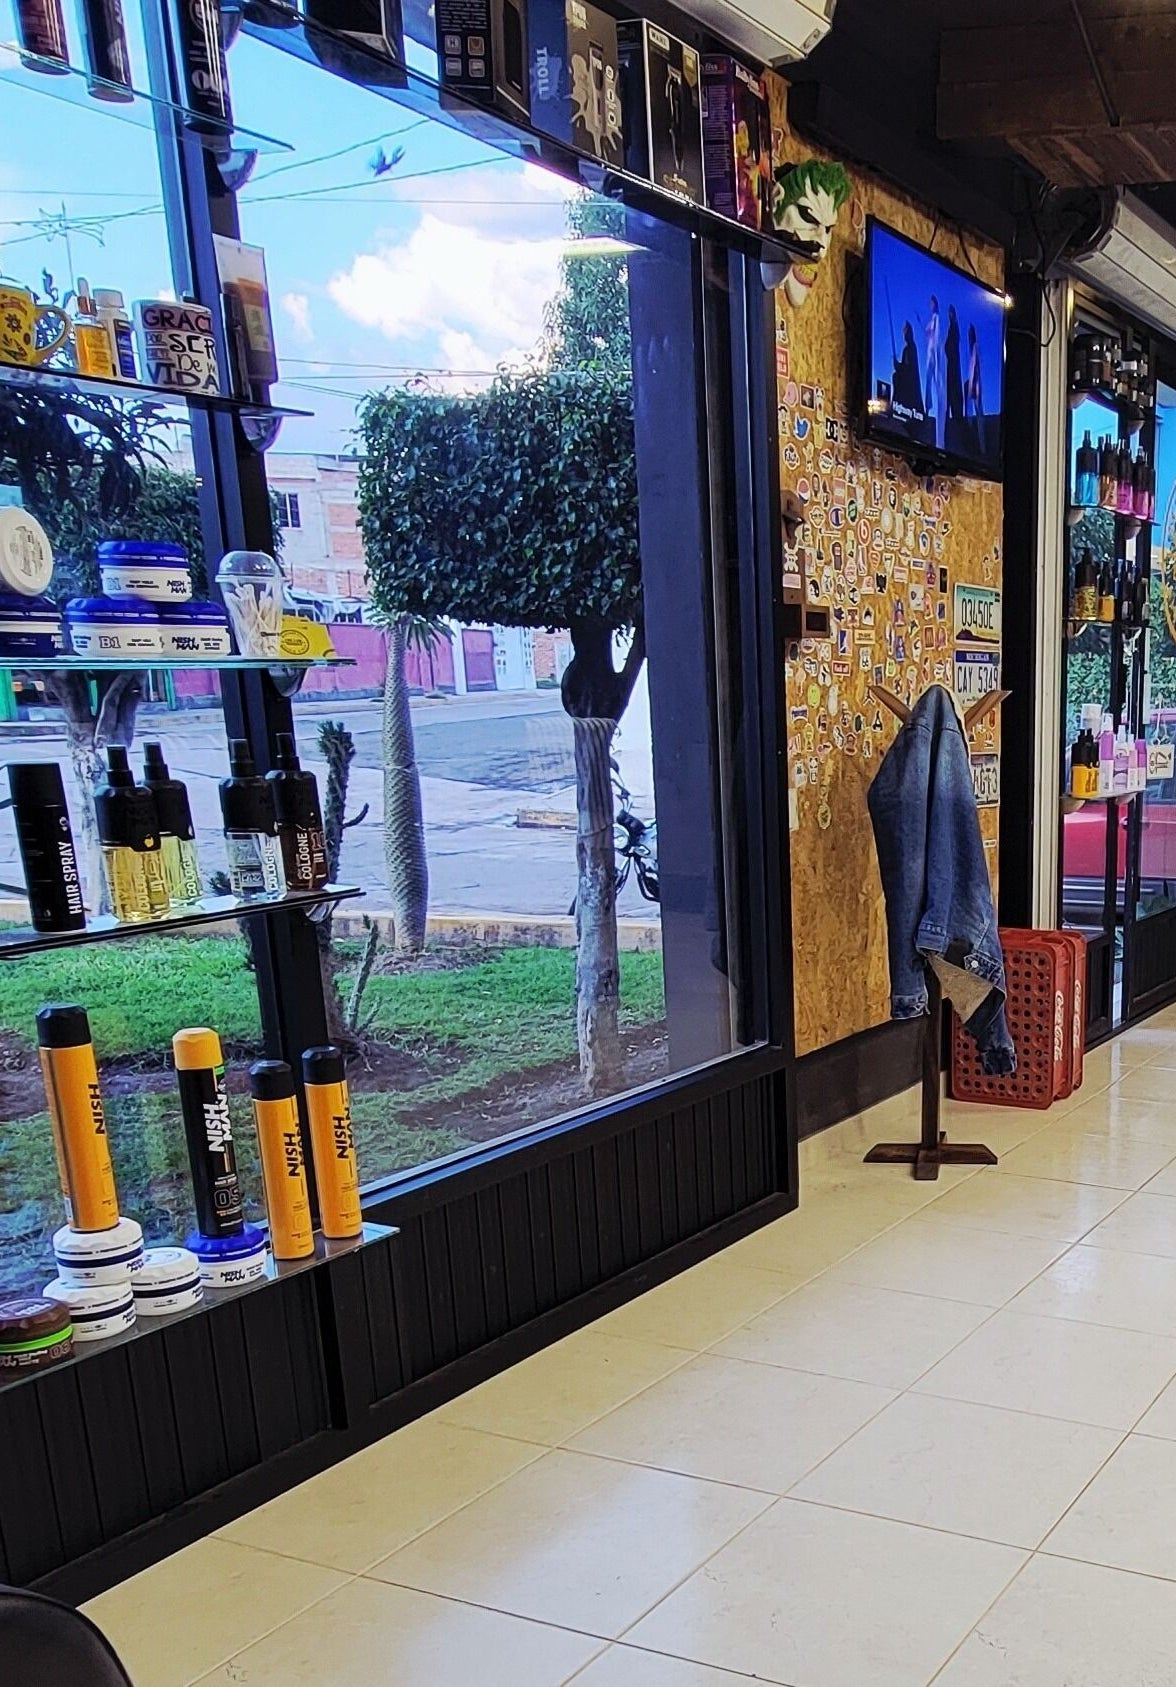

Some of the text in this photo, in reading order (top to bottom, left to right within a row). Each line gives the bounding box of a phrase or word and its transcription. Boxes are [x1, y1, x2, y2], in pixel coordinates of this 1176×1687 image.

[146, 362, 220, 392] VIDA
[57, 841, 83, 915] HAIR SPRAY
[295, 832, 313, 880] COLOGNE
[87, 1083, 106, 1136] NISH
[202, 1103, 225, 1153] NISH
[283, 1132, 300, 1178] NISH
[332, 1115, 349, 1160] NISH
